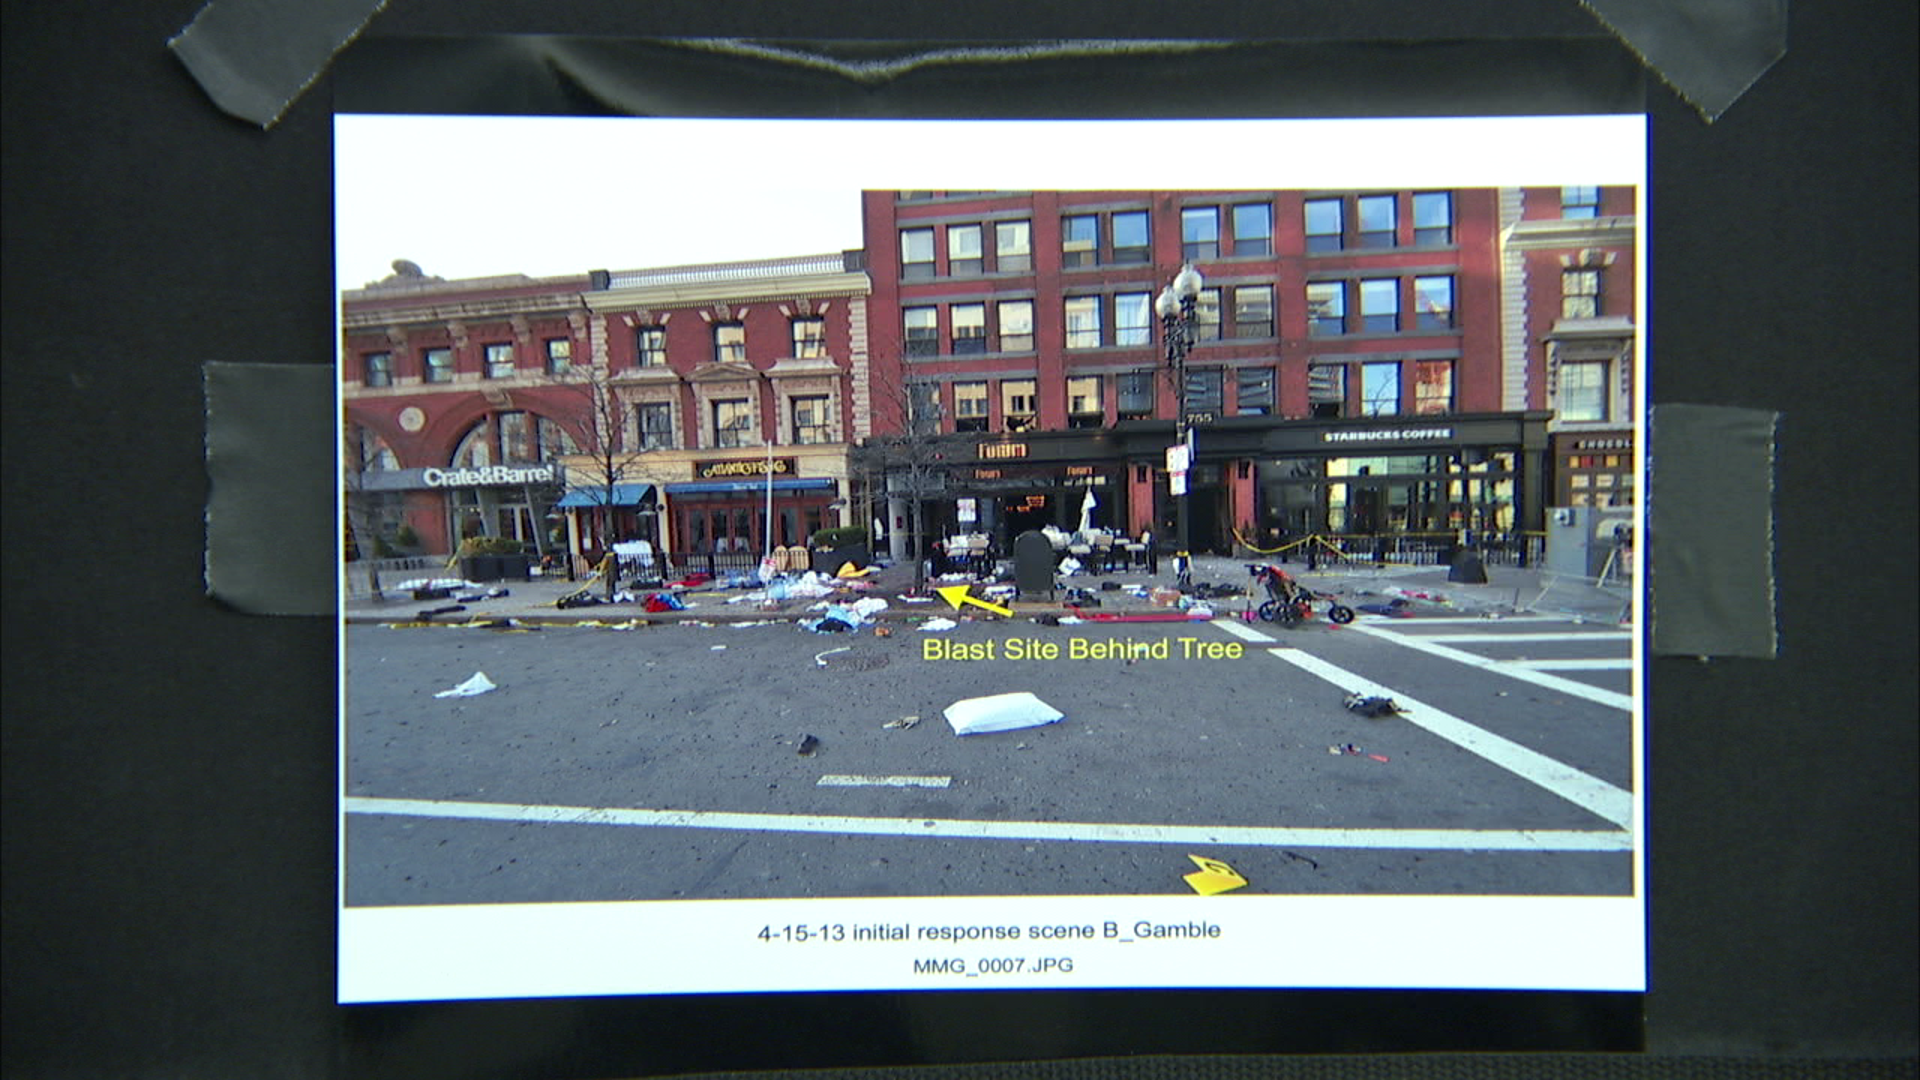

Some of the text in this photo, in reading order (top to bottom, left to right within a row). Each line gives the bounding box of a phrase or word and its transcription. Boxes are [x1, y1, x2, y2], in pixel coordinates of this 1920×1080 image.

[1324, 428, 1451, 442] STARBUCKS COFFEE
[423, 464, 553, 486] Crate&Barrel
[922, 637, 1243, 660] Blast Site Behind Tree
[757, 921, 1222, 944] 4-15-13 initial response scene B_Gamble
[913, 957, 1074, 977] MMG_0007.JPG
